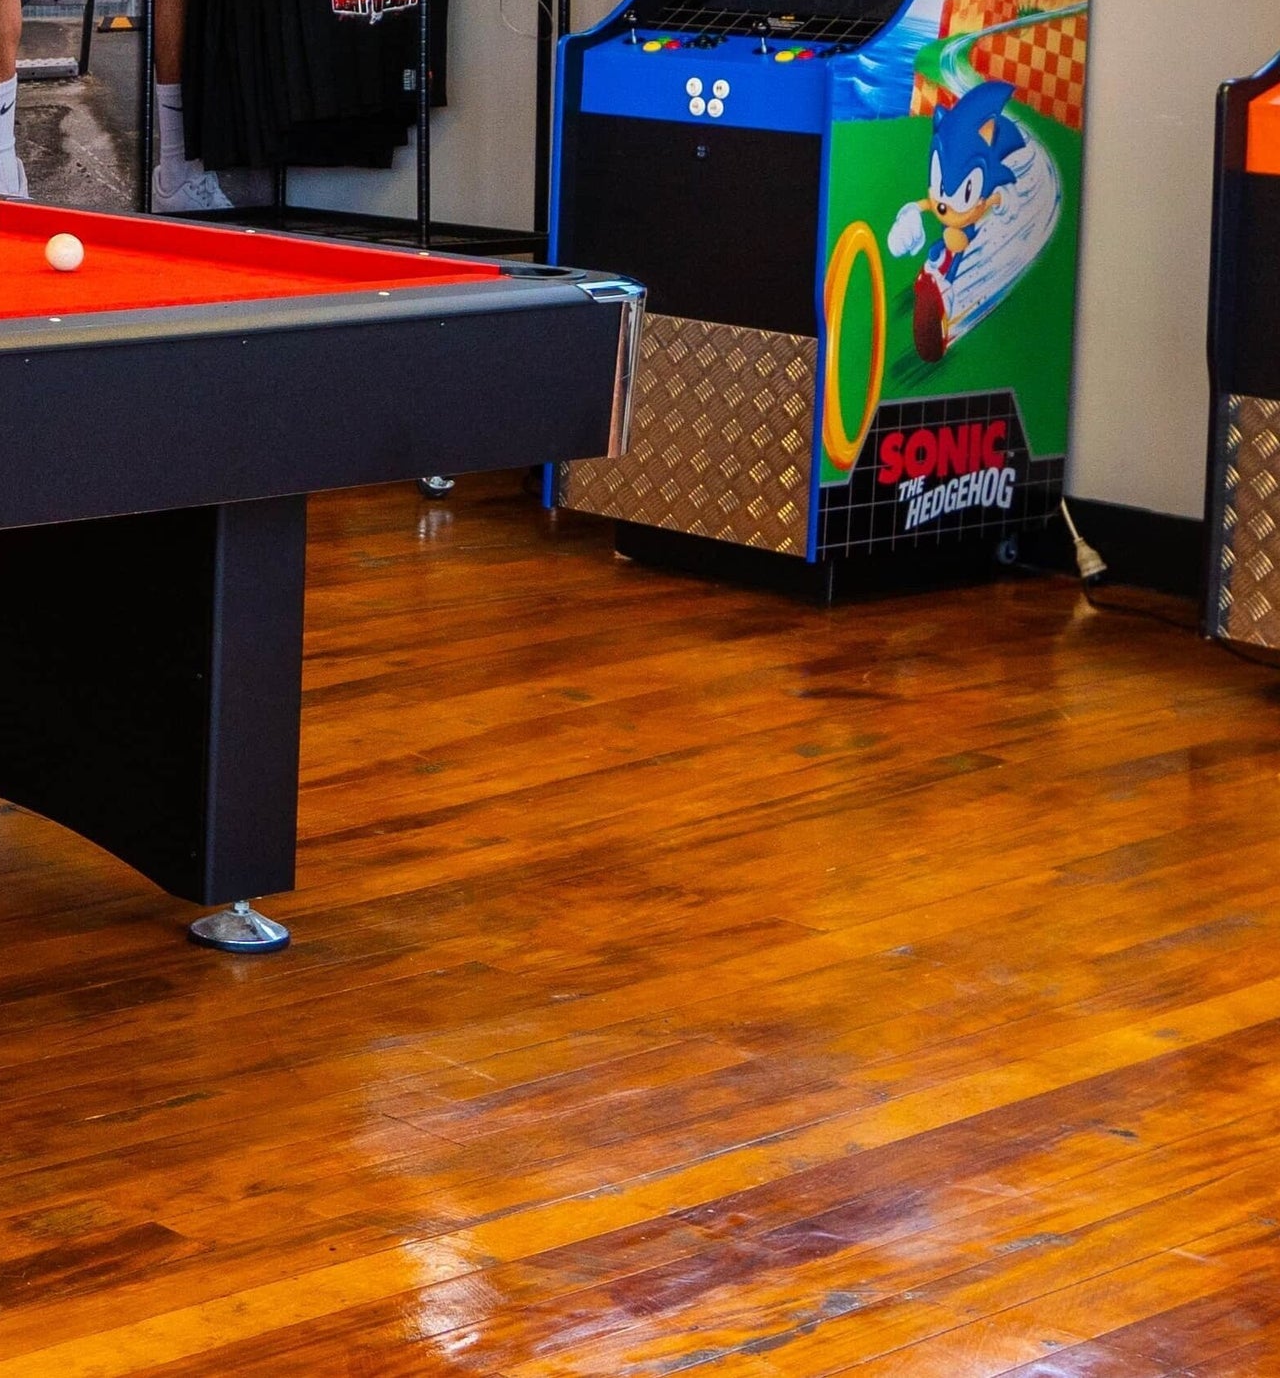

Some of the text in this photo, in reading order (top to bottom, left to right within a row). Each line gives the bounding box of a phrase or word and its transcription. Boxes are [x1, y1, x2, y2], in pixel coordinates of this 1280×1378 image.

[878, 420, 1007, 484] SONIC
[898, 474, 926, 502] THE
[904, 467, 1016, 530] HEDGEHOG
